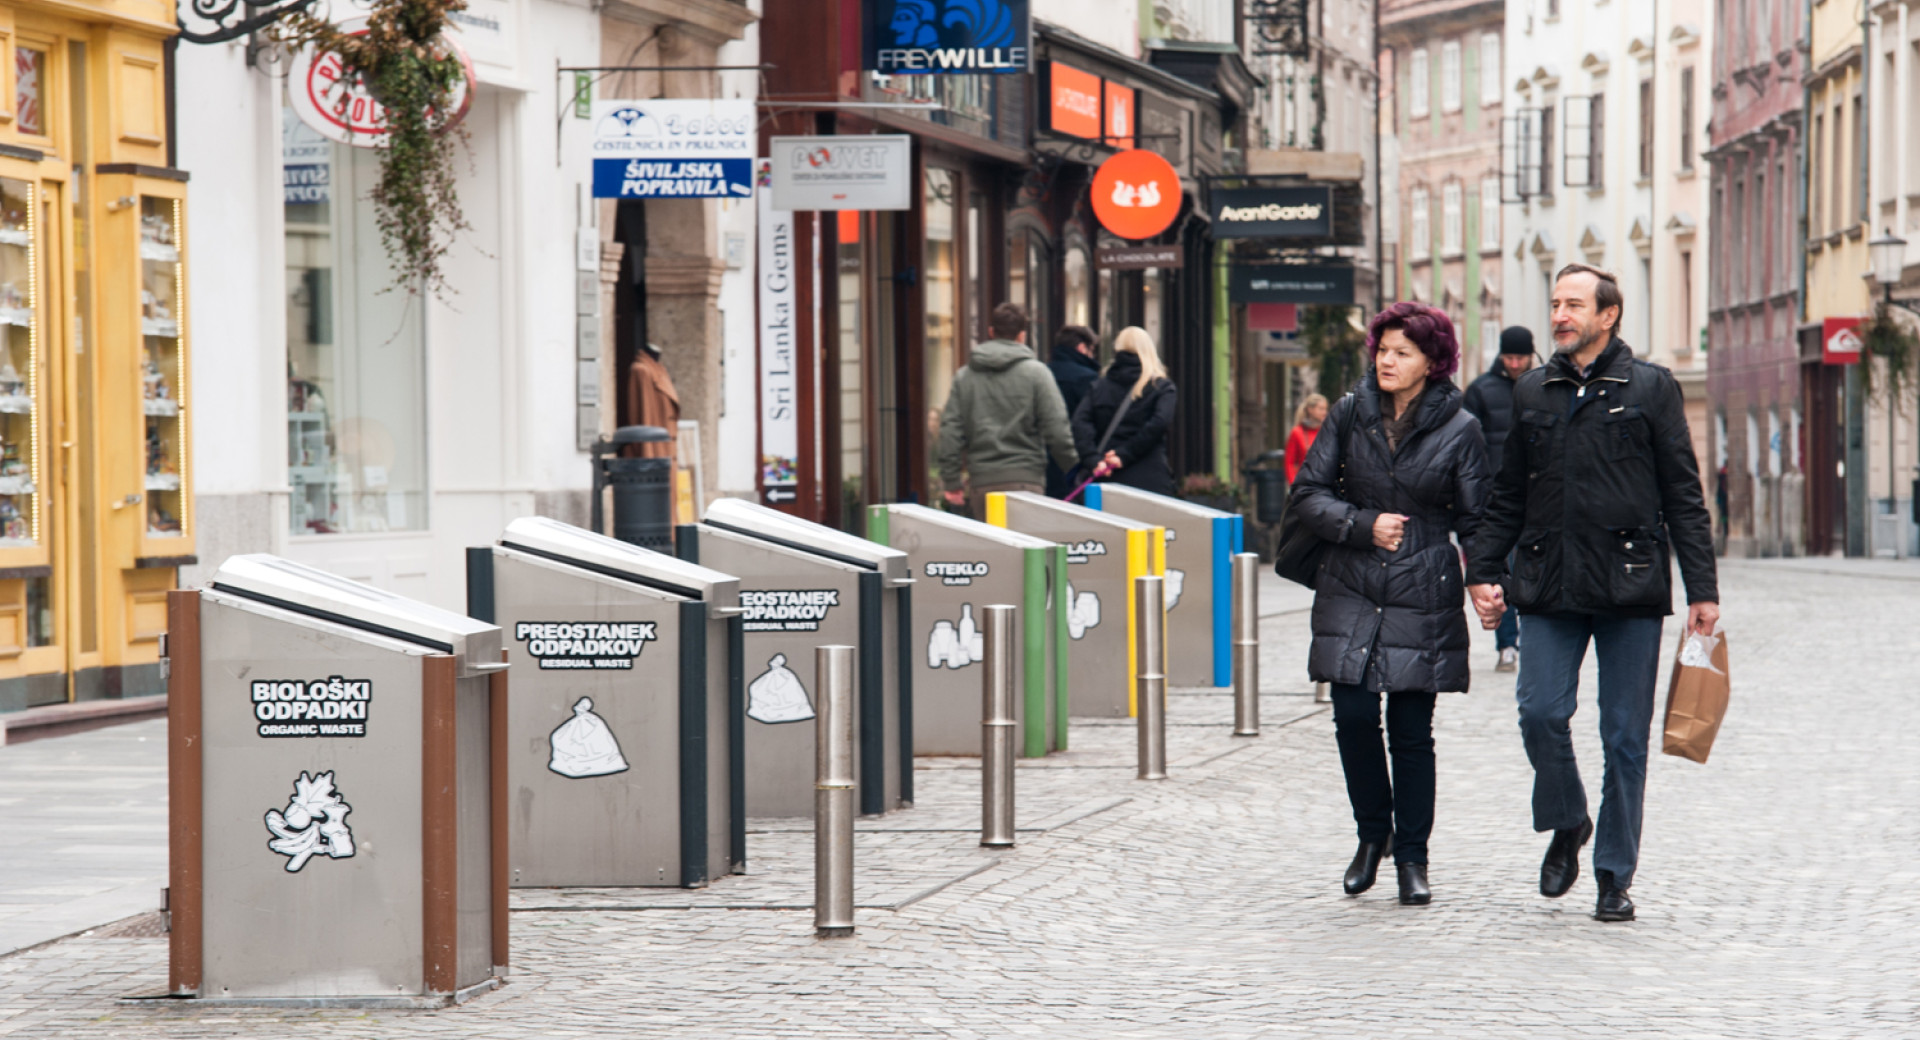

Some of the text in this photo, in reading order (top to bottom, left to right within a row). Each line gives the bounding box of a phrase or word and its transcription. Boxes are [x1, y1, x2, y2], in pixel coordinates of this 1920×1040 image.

[878, 47, 1025, 69] FREYWILLE
[593, 138, 747, 151] ČISTILNICA IN PRALNICA
[625, 159, 724, 178] ŠIVILJSKA
[621, 179, 728, 195] POPRAVILA
[1219, 203, 1321, 221] AvantGarde
[766, 223, 791, 422] Sri Lanka Gems
[1066, 539, 1106, 555] LAŽA
[926, 562, 988, 576] STEKLO
[740, 590, 838, 606] EOSTANEK
[516, 623, 655, 639] PREOSTANEK
[529, 640, 645, 656] ODPADKOV
[541, 659, 632, 668] RESIDUAL WASTE
[252, 679, 370, 701] BIOLOŠKI
[256, 701, 366, 720] ODPADKI
[259, 724, 364, 735] ORGANIC WASTE
